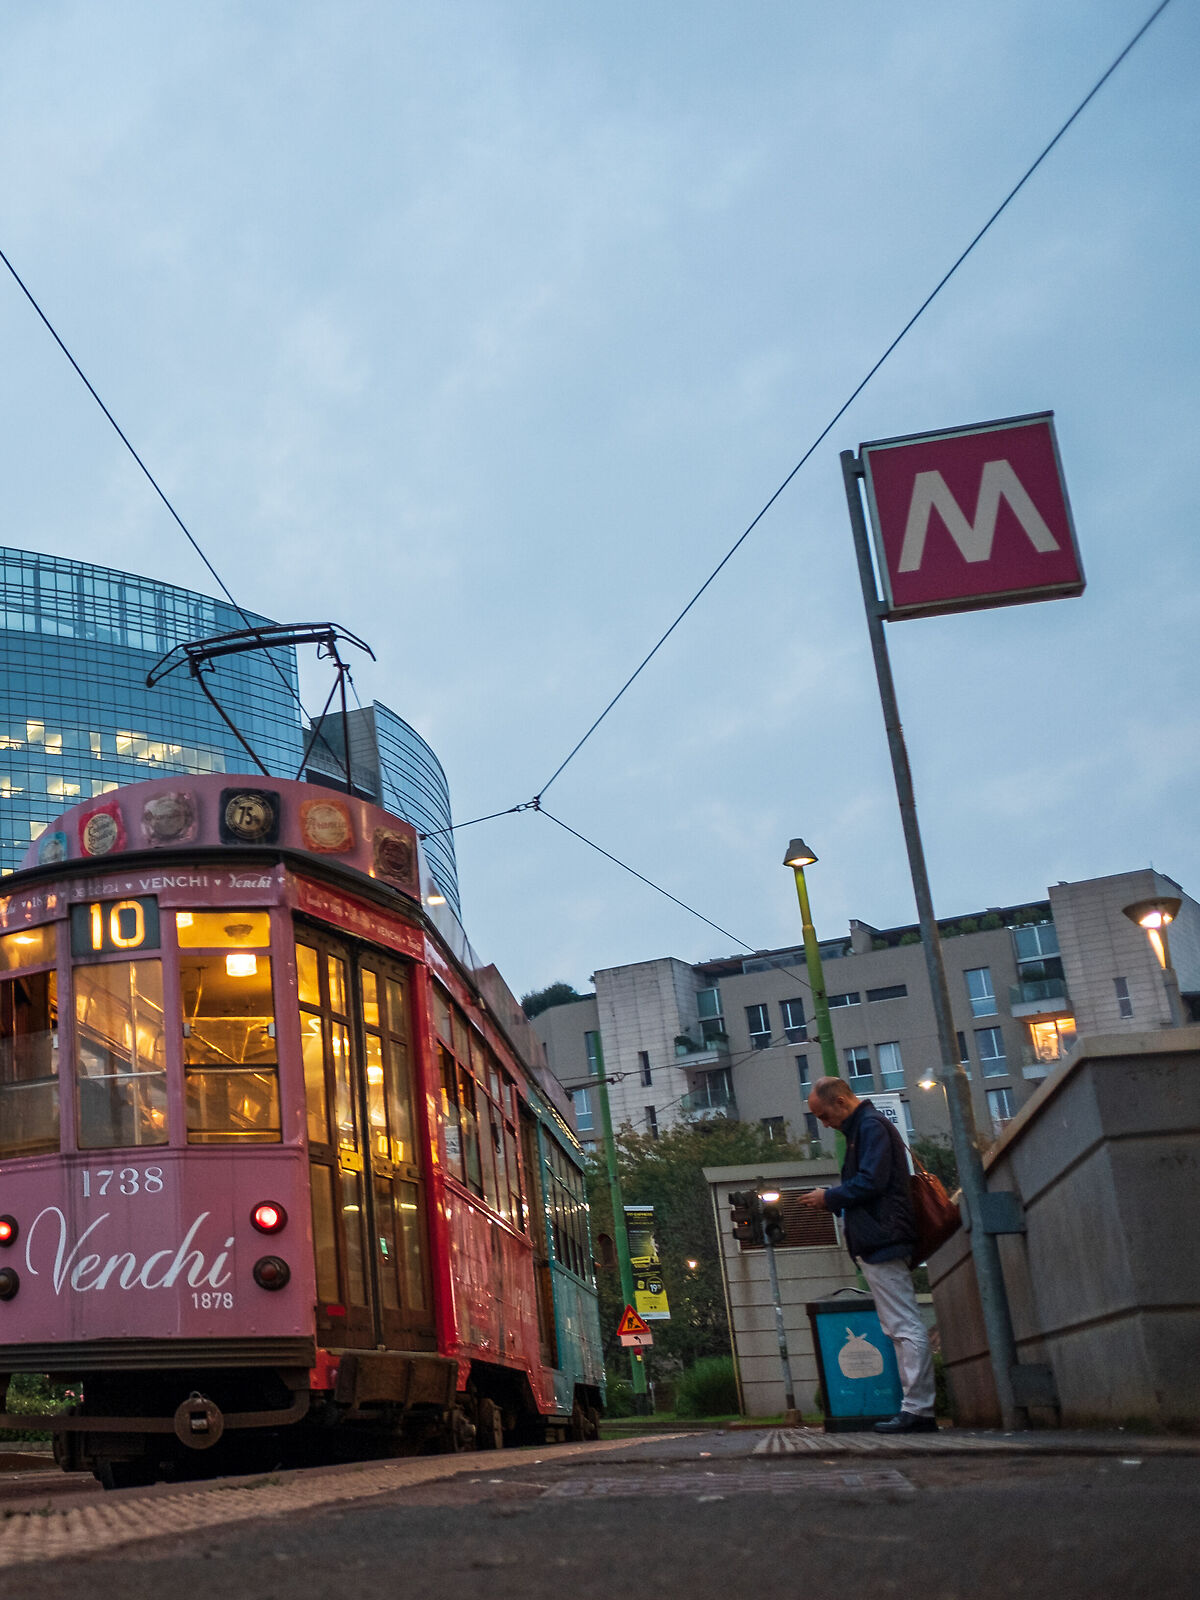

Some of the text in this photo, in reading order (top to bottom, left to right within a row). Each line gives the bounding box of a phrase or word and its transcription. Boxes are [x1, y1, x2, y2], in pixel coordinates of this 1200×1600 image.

[897, 459, 1061, 573] M
[138, 875, 209, 891] VENCHI
[89, 899, 146, 951] 10
[81, 1166, 165, 1198] 1738
[25, 1206, 236, 1296] Venchi
[191, 1292, 234, 1309] 1878
